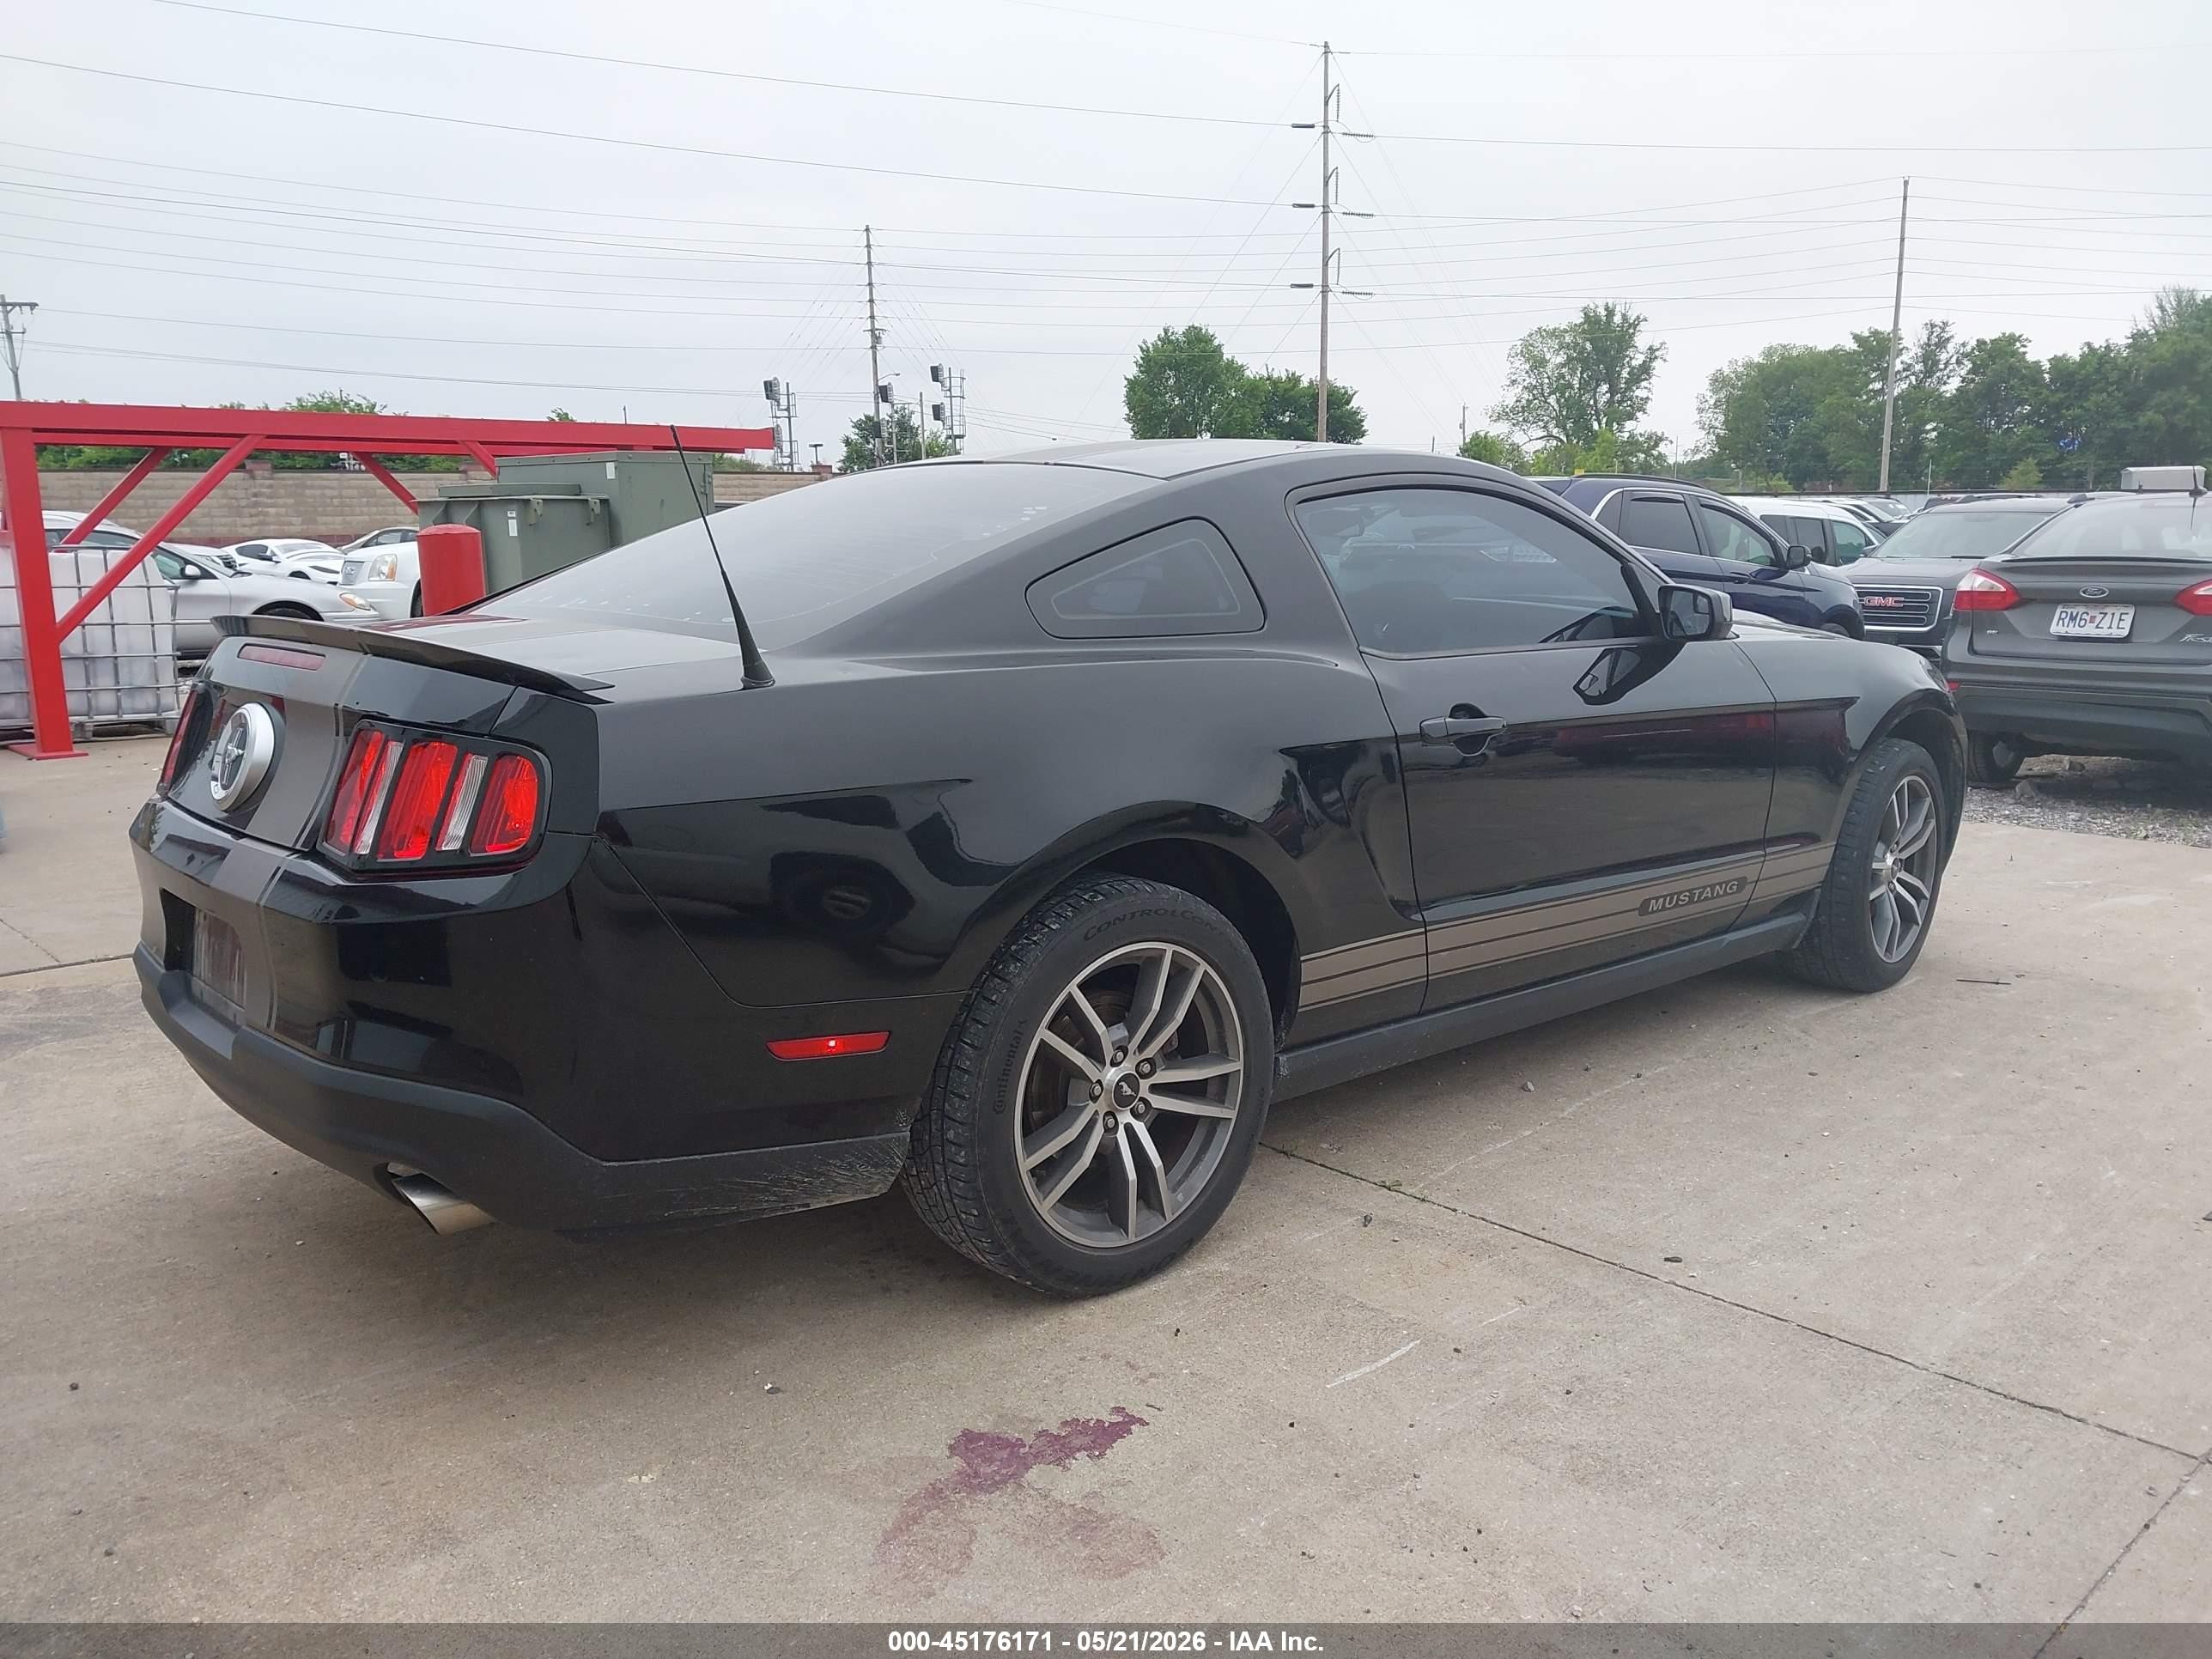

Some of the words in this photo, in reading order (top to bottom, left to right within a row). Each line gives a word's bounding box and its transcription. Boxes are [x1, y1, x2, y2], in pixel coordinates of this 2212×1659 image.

[1863, 596, 1905, 608] GMC
[2055, 610, 2090, 629] RM6
[2095, 611, 2130, 629] Z1E
[1648, 881, 1739, 912] MUSTANG
